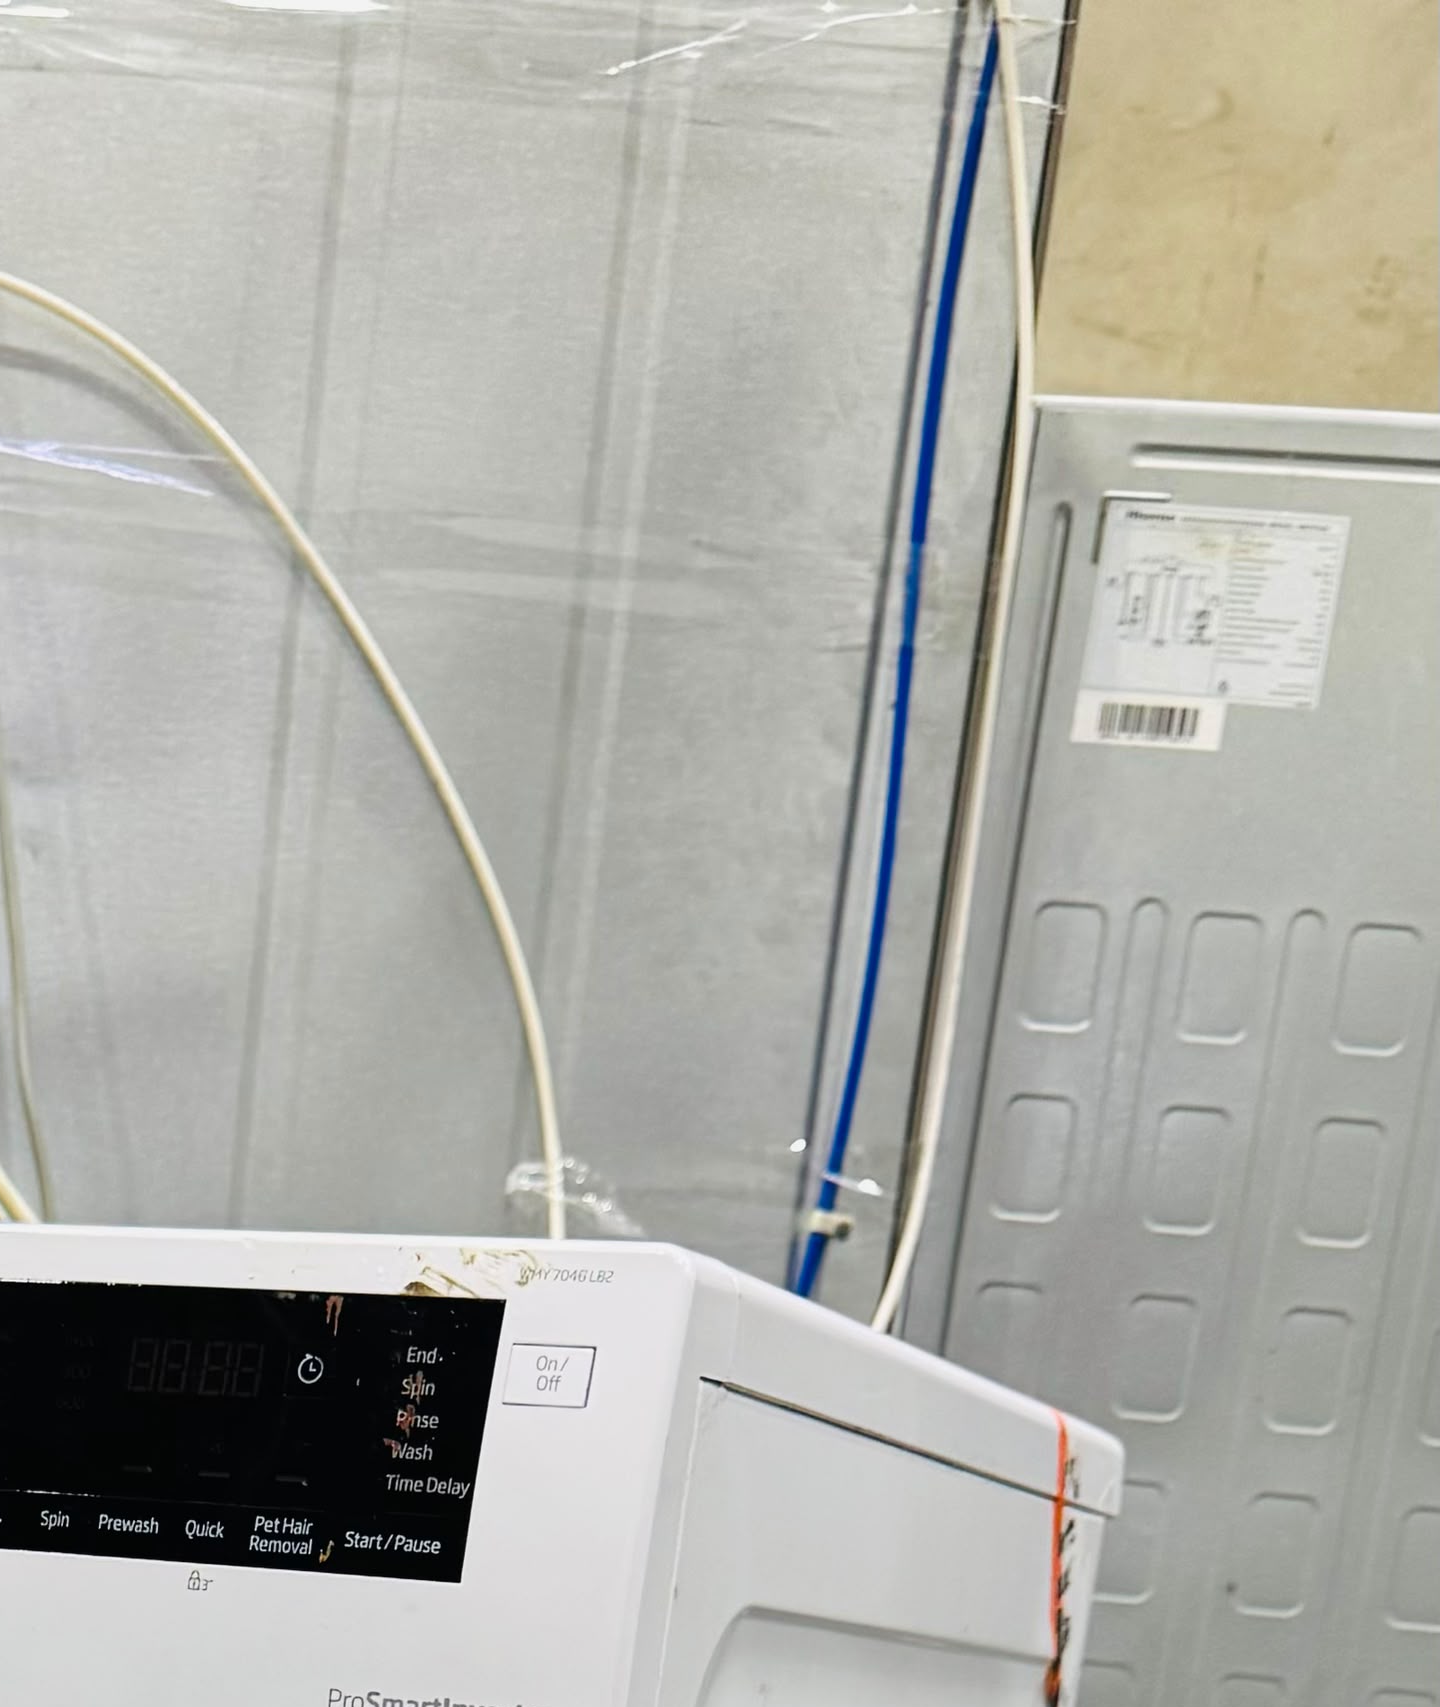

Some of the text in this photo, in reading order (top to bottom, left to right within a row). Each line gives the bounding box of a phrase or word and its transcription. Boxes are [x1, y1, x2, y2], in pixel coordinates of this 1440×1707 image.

[406, 1346, 439, 1364] End
[401, 1374, 436, 1400] Spin
[535, 1375, 562, 1393] Off
[396, 1407, 440, 1429] Rnse
[391, 1442, 433, 1461] Wash
[386, 1473, 471, 1500] Time Delay
[40, 1510, 70, 1531] Spin
[98, 1513, 160, 1535] Prewash
[185, 1518, 225, 1540] Quick
[253, 1515, 314, 1536] Pet Hair
[249, 1534, 313, 1555] Removal
